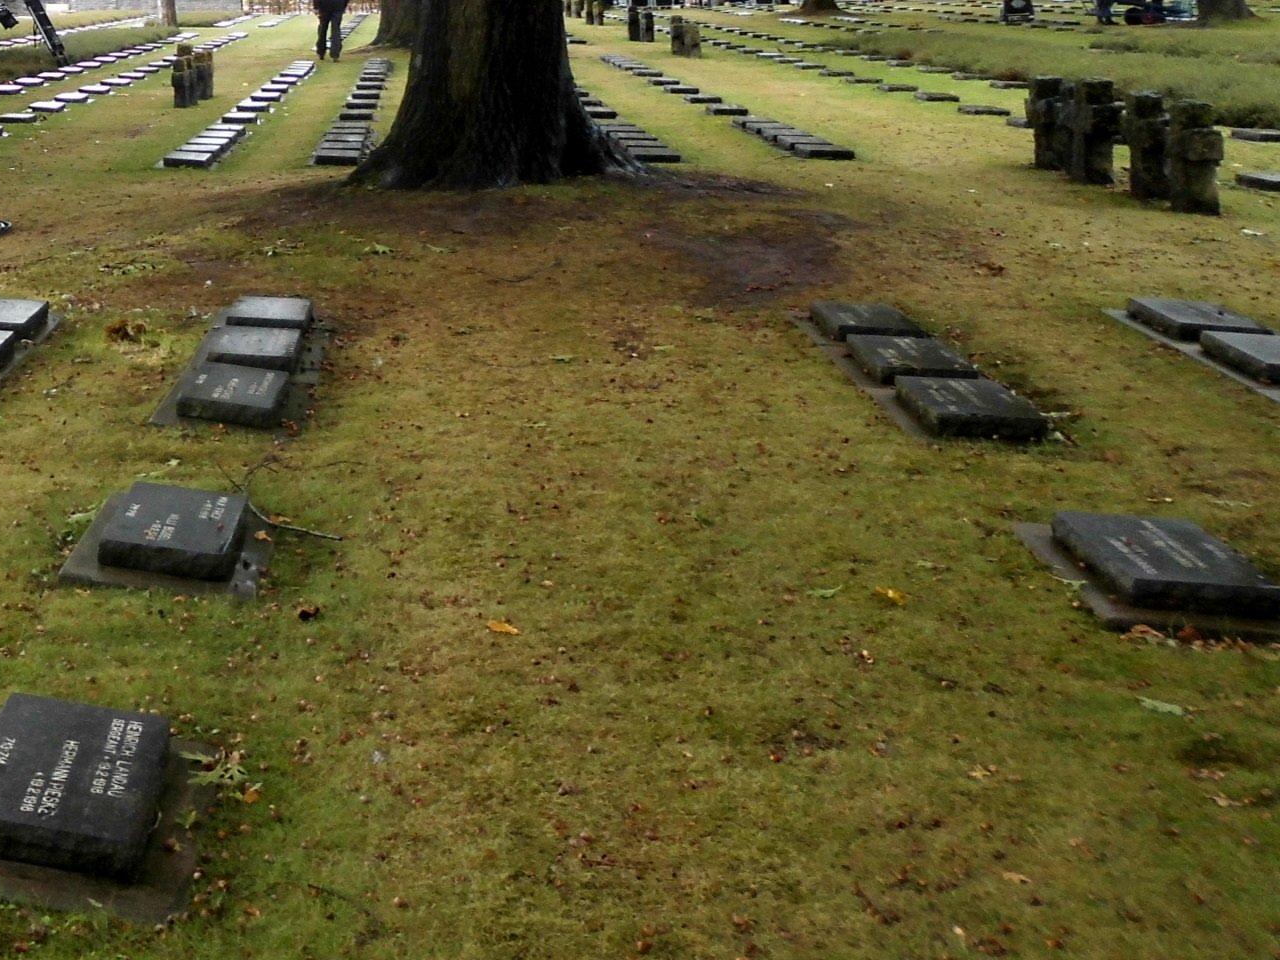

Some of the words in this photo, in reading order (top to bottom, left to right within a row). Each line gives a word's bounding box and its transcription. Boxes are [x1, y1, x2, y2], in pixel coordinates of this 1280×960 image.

[104, 718, 125, 755] SERGEANT
[51, 739, 80, 782] HERMANN
[107, 760, 133, 798] LANDAU
